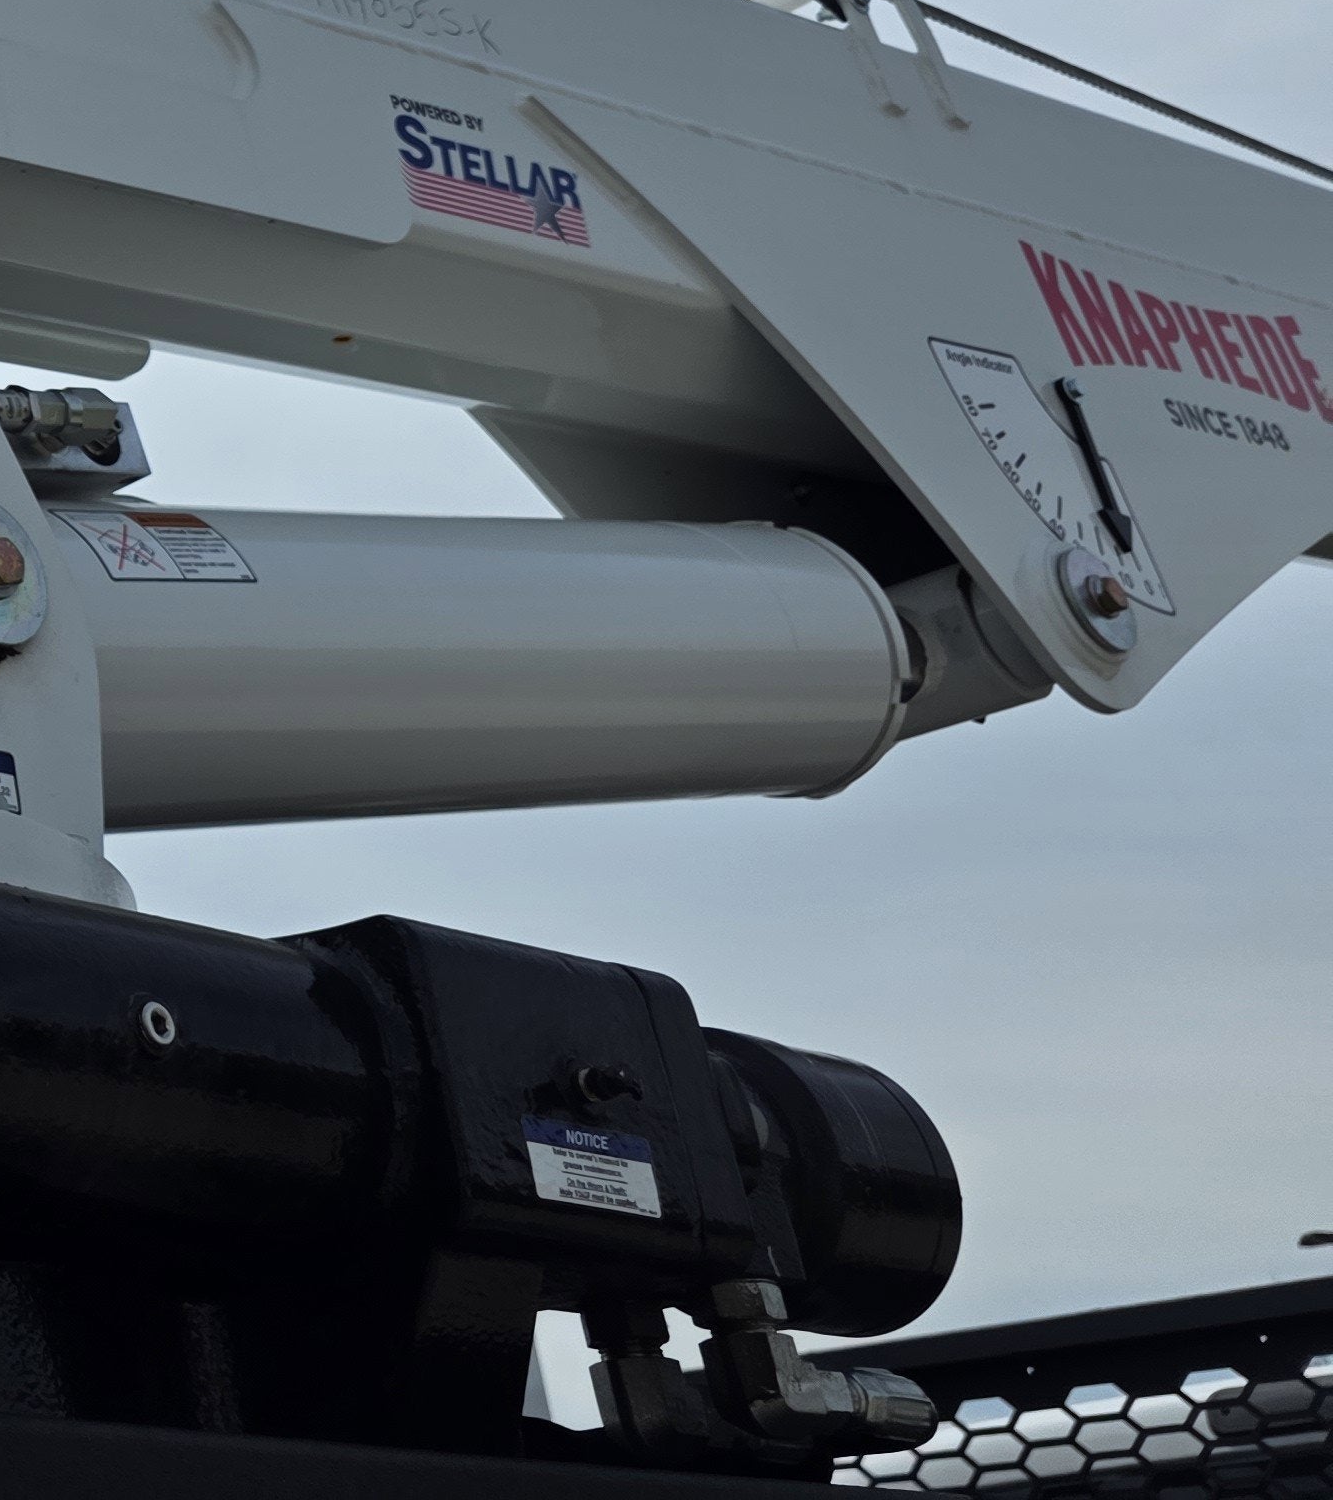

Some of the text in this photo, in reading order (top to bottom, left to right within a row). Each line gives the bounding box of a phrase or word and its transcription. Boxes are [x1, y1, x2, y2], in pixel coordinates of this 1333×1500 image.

[389, 94, 483, 132] POWERED BY
[393, 114, 583, 211] STELLAR
[1018, 239, 1333, 426] KNAPHEIDE
[1162, 398, 1291, 453] SINCE 1848
[565, 1129, 609, 1149] NOTICE
